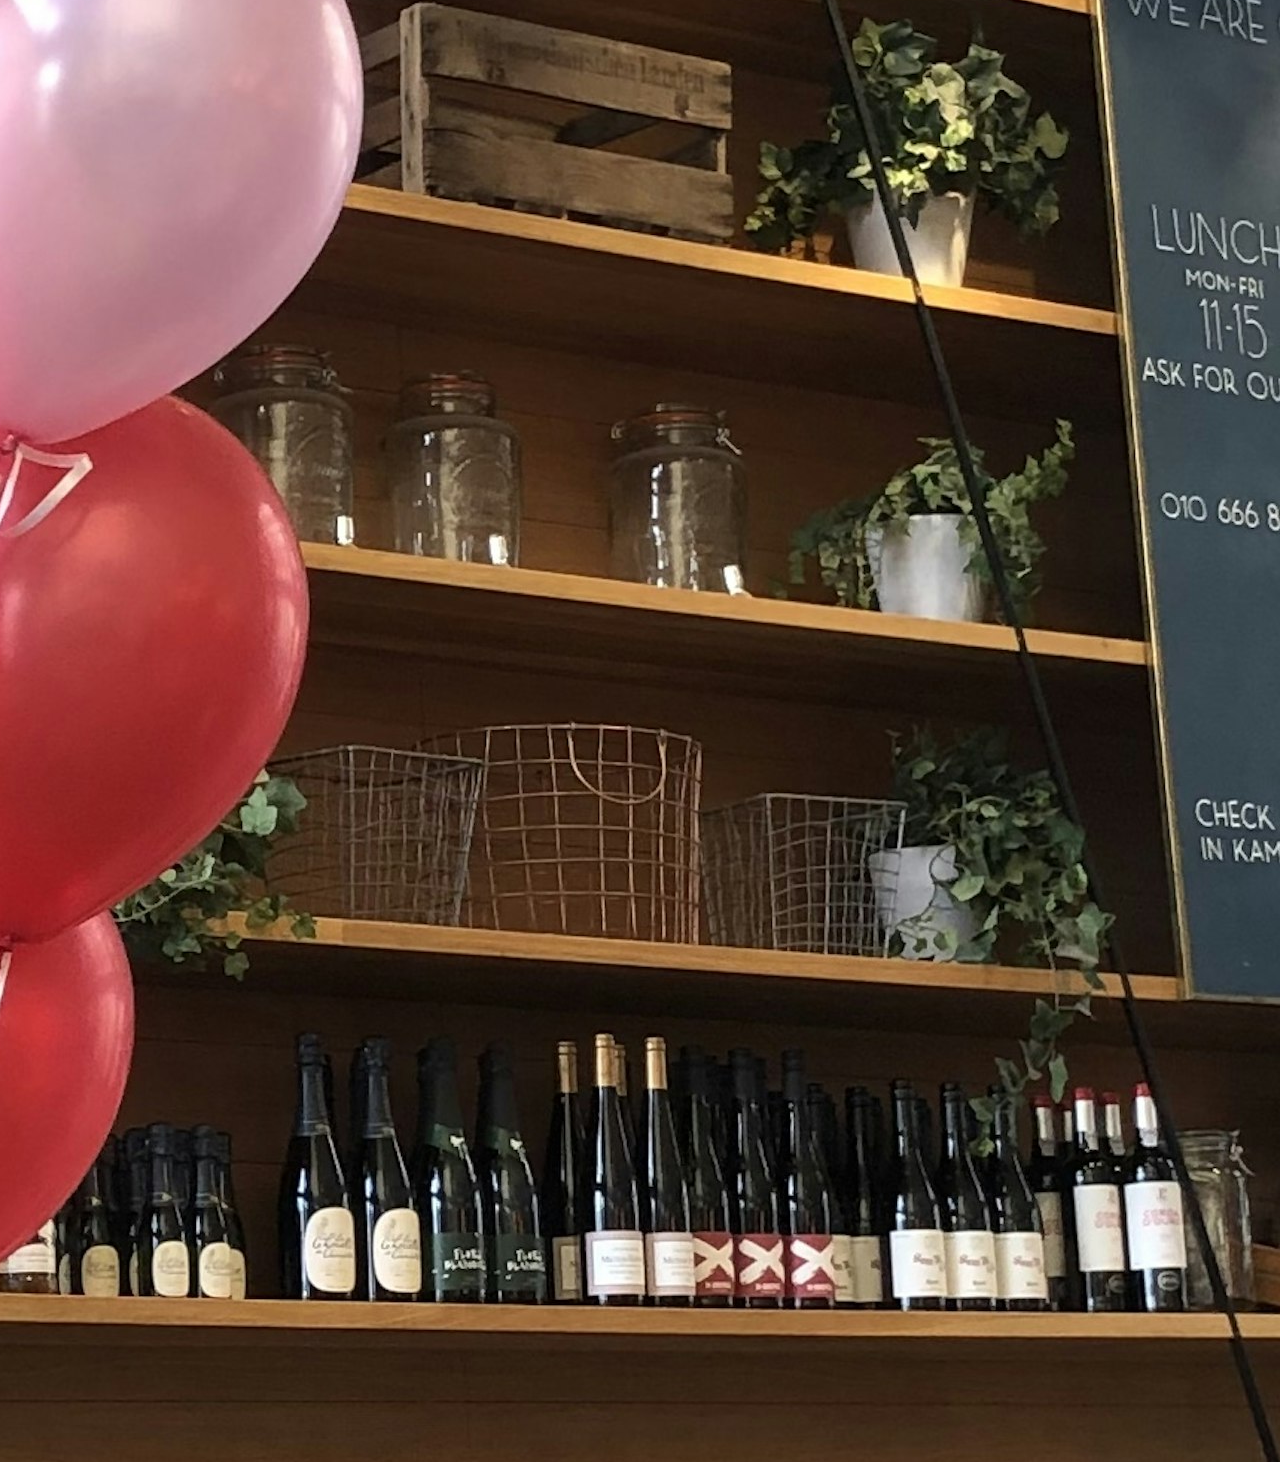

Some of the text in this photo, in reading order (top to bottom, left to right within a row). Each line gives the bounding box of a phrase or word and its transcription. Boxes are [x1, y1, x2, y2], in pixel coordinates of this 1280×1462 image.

[1184, 268, 1265, 300] MON-FRI
[1199, 298, 1268, 359] 11-15
[1142, 356, 1186, 388] ASK
[1192, 363, 1238, 396] FOR
[1160, 492, 1208, 522] 010
[1218, 499, 1260, 530] 666
[1195, 798, 1276, 832] CHECK
[1200, 836, 1223, 862] IN
